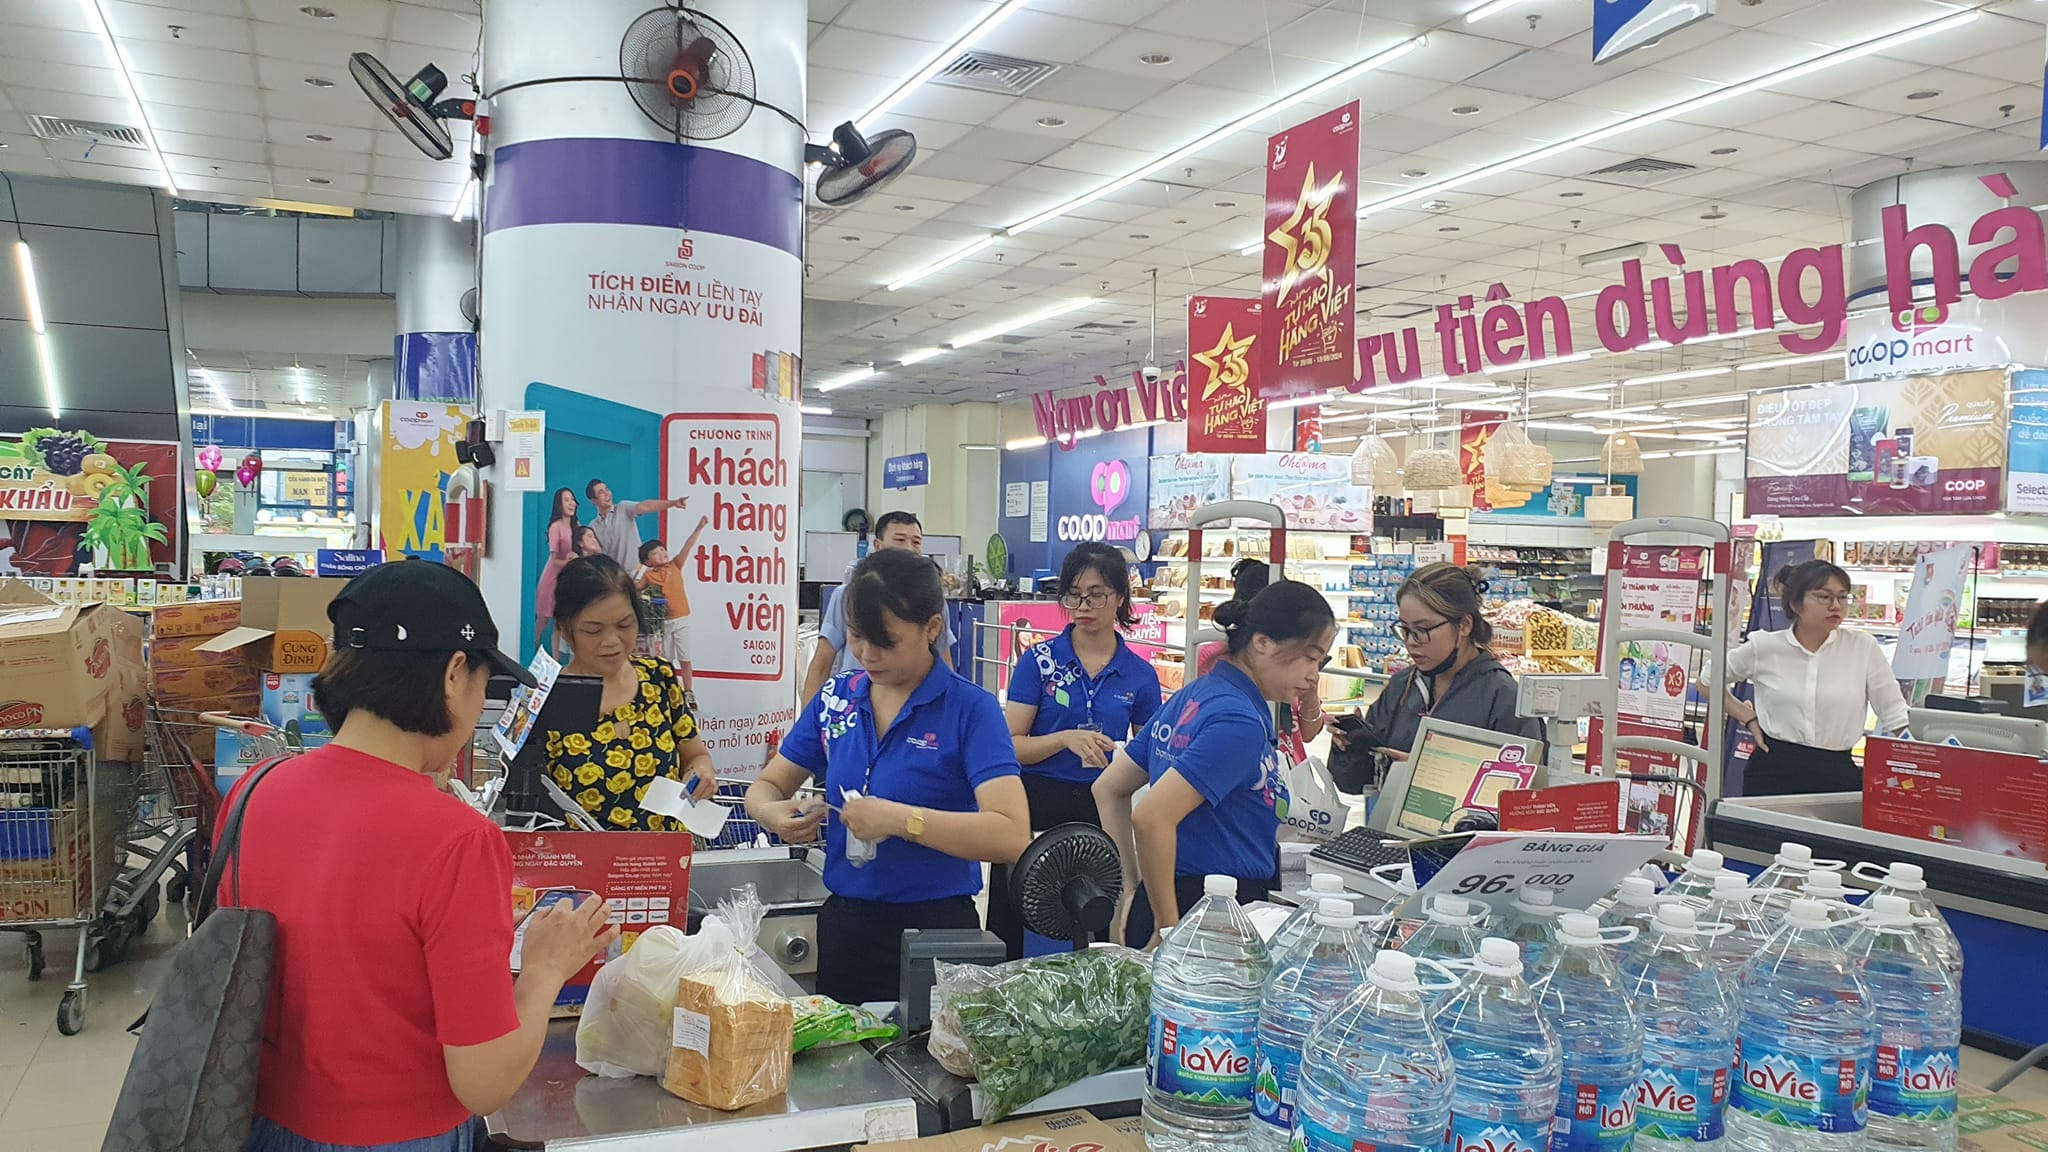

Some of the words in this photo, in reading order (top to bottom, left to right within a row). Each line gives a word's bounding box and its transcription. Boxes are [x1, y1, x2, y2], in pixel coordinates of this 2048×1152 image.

[588, 271, 634, 292] TÍCH
[640, 271, 691, 296] ĐIỂM
[697, 279, 735, 302] LIỀN
[739, 289, 763, 307] TAY
[588, 292, 643, 315] NHẬN
[649, 297, 702, 317] NGAY
[706, 303, 735, 322] ƯU
[739, 306, 763, 328] ĐÃI
[1279, 313, 1319, 366] HÀNG
[1321, 268, 1351, 323] VIỆT
[1434, 282, 1573, 377] tiên
[1595, 244, 1847, 354] dùng
[1032, 375, 1132, 451] Người
[688, 446, 787, 487] khách
[0, 481, 72, 510] KHẨU
[1944, 479, 1986, 492] COOP
[713, 492, 787, 542] hàng
[694, 544, 786, 585] thành
[726, 592, 785, 632] viên
[281, 642, 316, 654] CUNG
[743, 639, 776, 651] SAIGON
[750, 653, 776, 666] CO.OP
[699, 717, 726, 732] hận
[729, 717, 756, 731] ngay
[744, 732, 762, 746] 100
[1521, 840, 1574, 853] BẢNG
[1576, 842, 1609, 853] GIÁ
[1524, 873, 1575, 886] 000
[1180, 1045, 1249, 1074] laVie
[1743, 1060, 1818, 1100] laVie
[1903, 1064, 1958, 1091] laVie
[1637, 1079, 1697, 1112] aVie
